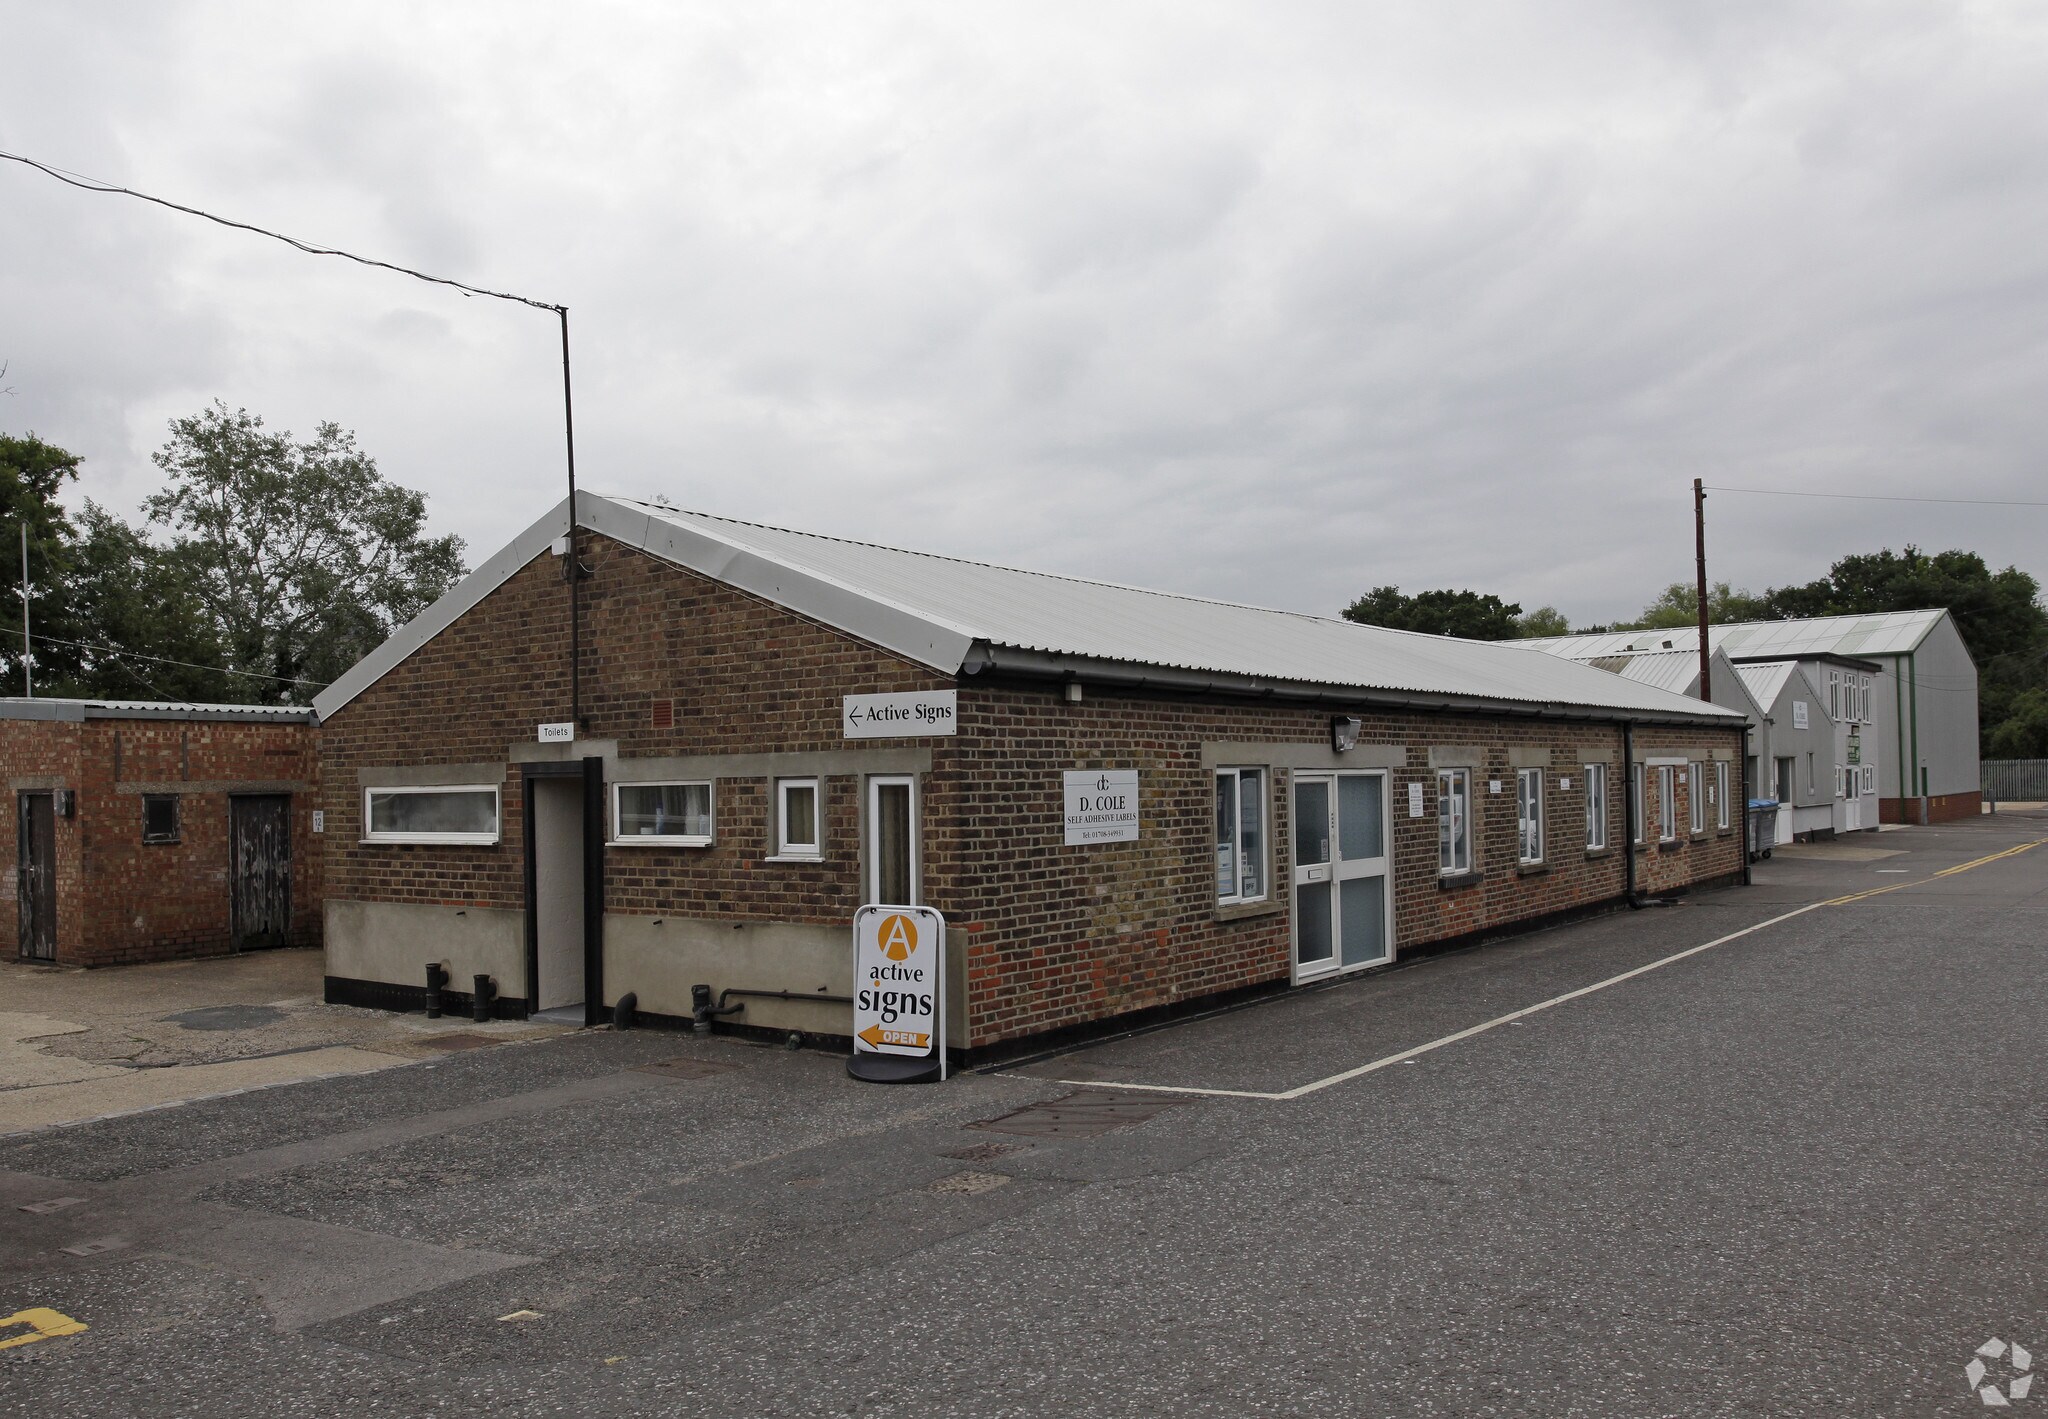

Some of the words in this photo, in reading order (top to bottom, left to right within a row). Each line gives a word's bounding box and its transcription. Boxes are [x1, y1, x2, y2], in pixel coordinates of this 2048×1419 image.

[866, 704, 909, 721] Active
[915, 703, 952, 724] Signs
[544, 727, 568, 737] Toilets
[1079, 796, 1093, 812] D.
[1096, 795, 1126, 811] COLE
[314, 817, 322, 827] 12
[1067, 815, 1083, 824] SELF
[1084, 813, 1115, 823] ADHESIVE
[1116, 812, 1137, 821] LABELS
[881, 914, 914, 958] A
[869, 961, 923, 982] active
[858, 980, 932, 1024] signs
[882, 1031, 918, 1045] OPEN
